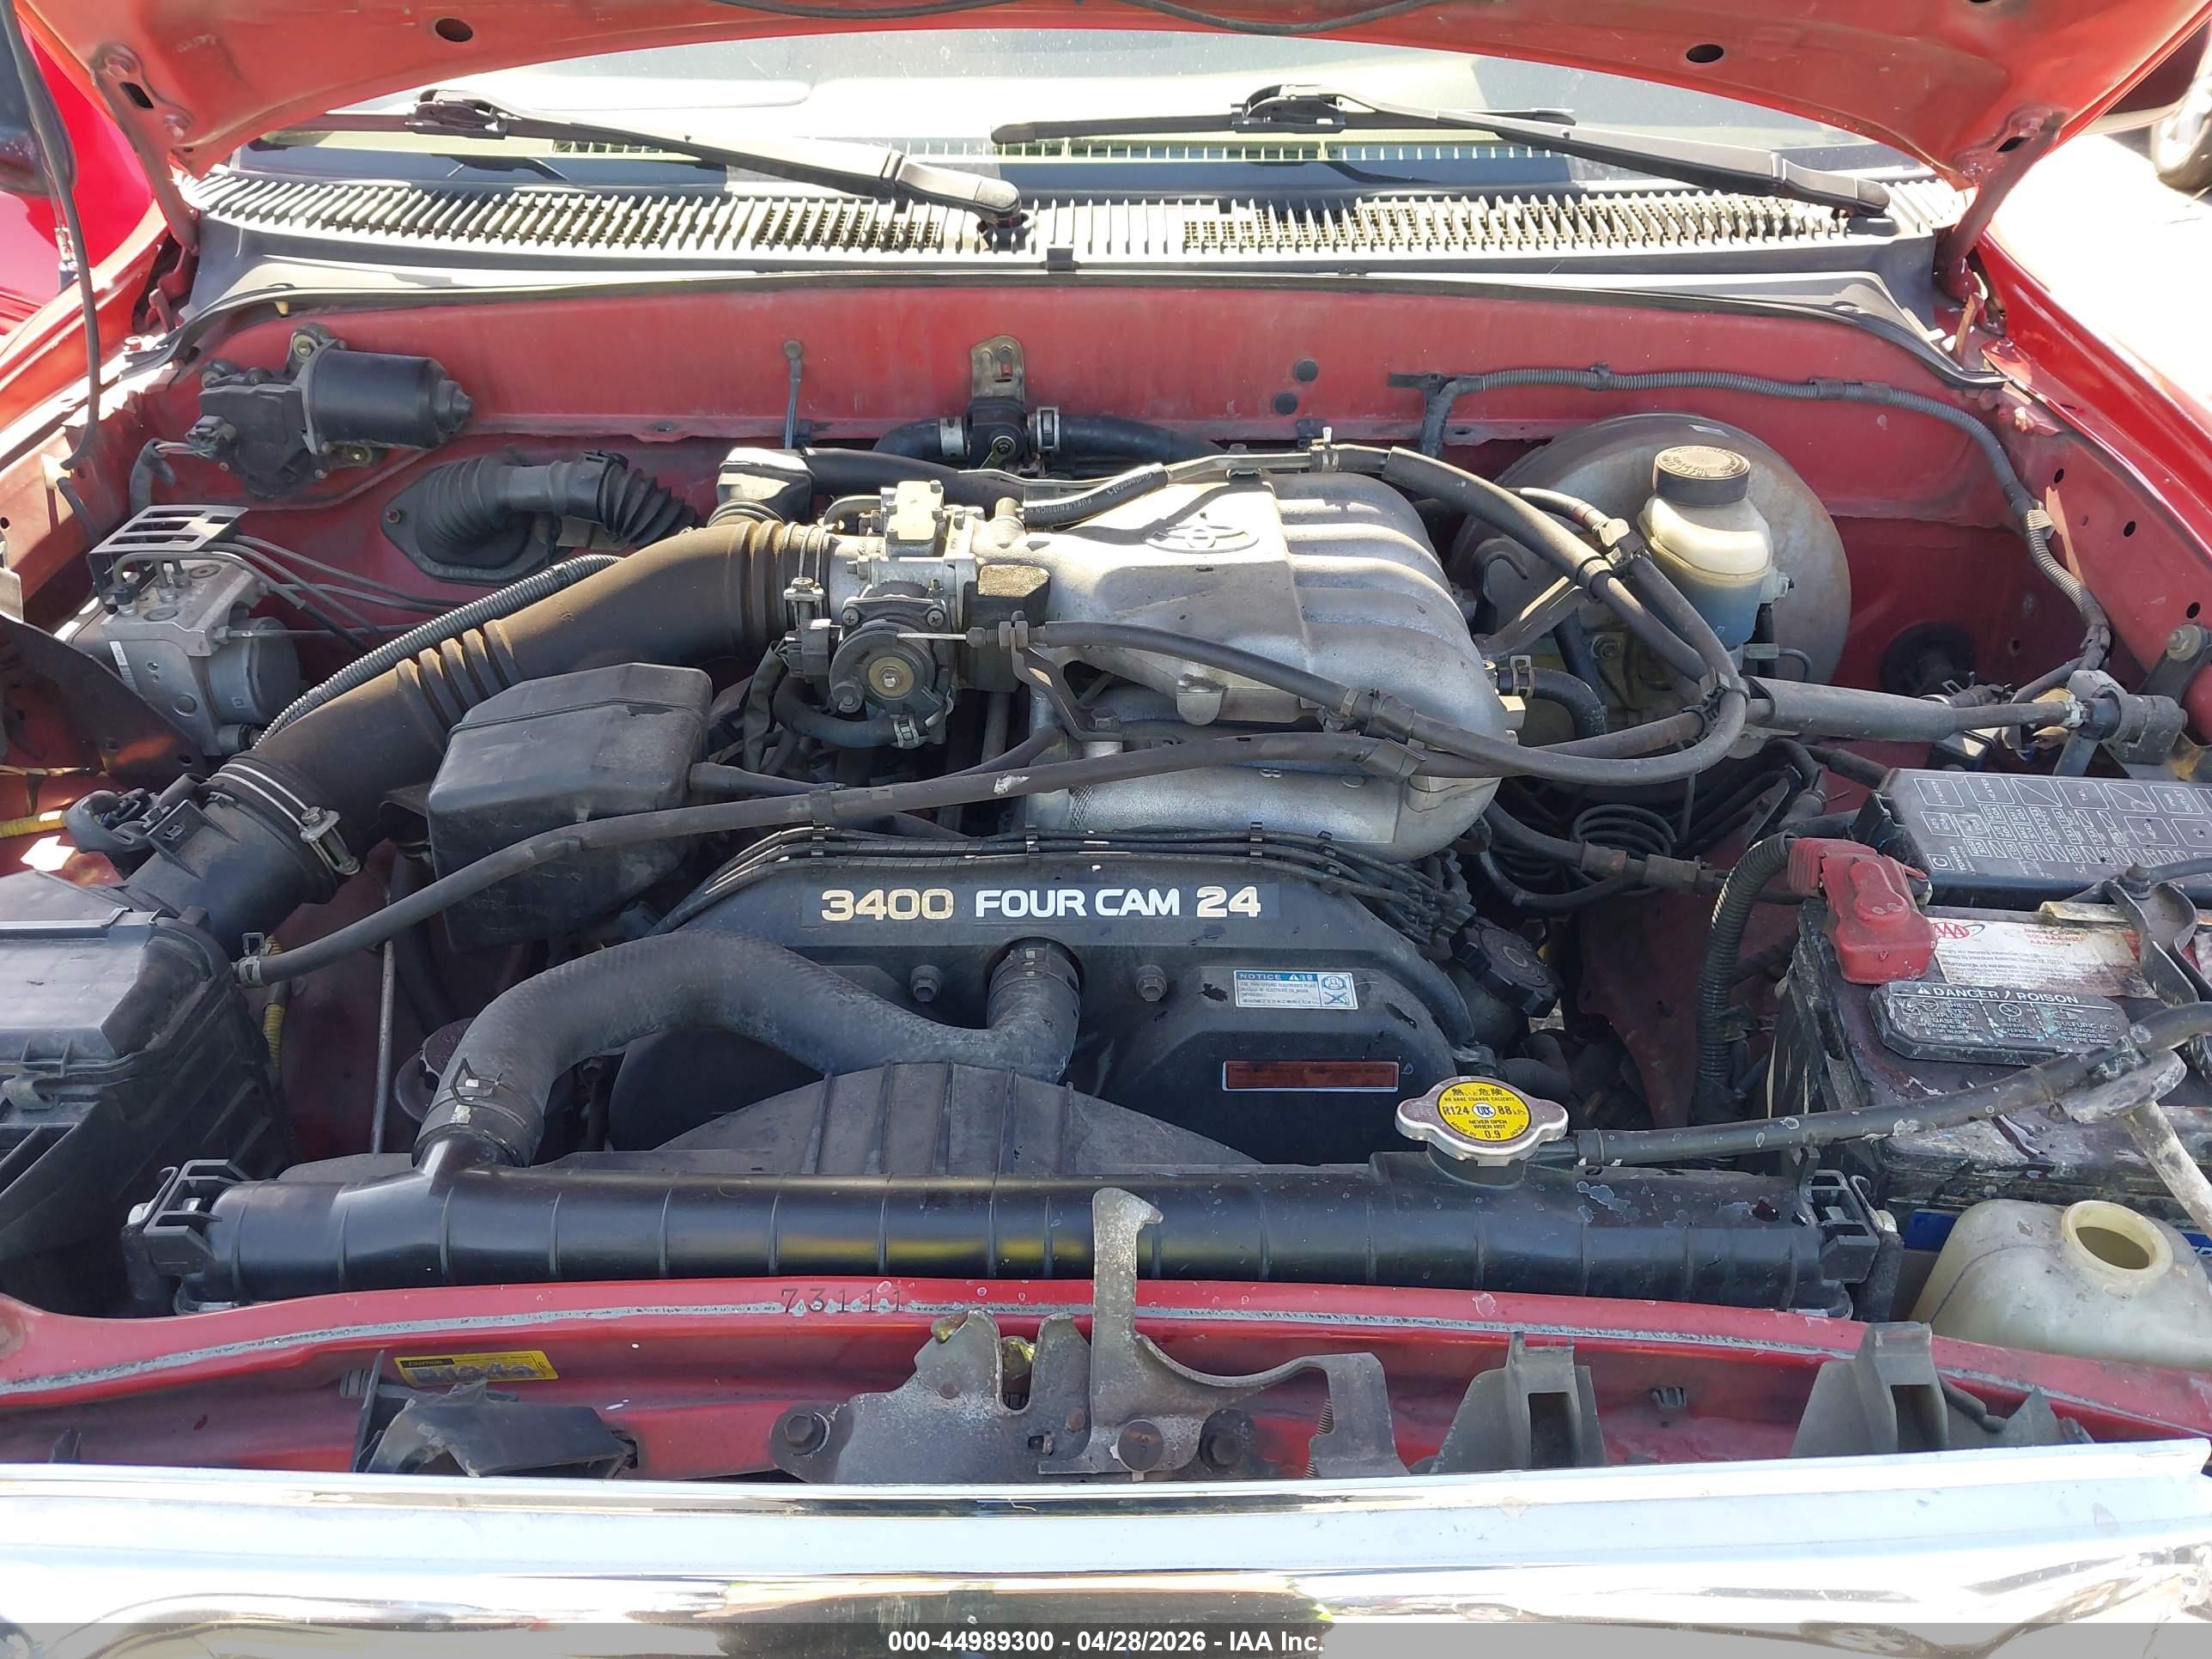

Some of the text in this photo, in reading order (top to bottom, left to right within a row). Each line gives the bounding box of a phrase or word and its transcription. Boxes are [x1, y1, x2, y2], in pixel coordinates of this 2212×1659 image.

[1980, 778, 2000, 801] HEATER
[1948, 845, 1967, 871] TOYOTA
[821, 886, 1261, 921] 3400 FOUR CAM 24
[1933, 987, 2000, 1000] DANGER
[2015, 992, 2079, 1004] POISON
[1945, 1000, 1974, 1009] SHIELD
[1442, 1105, 1470, 1115] R124
[1497, 1105, 1512, 1115] 88
[1450, 1121, 1469, 1133] MADE
[1510, 1123, 1526, 1137] JAPAN
[1484, 1130, 1501, 1139] 0.9
[781, 1288, 902, 1313] 73111
